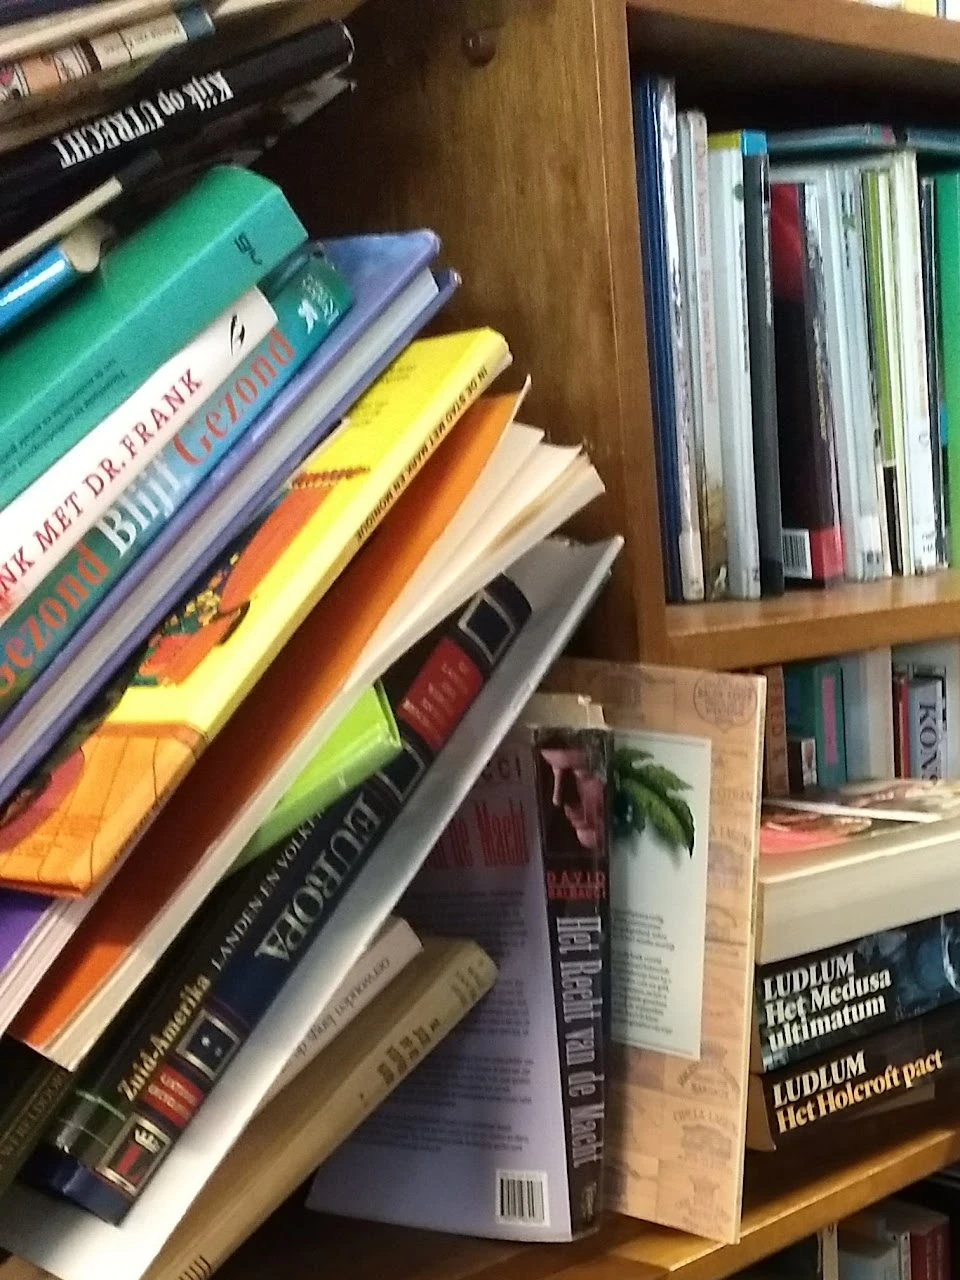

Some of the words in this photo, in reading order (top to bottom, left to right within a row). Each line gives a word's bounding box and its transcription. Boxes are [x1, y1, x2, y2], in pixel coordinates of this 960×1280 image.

[158, 90, 185, 116] op
[182, 70, 234, 111] Kijk
[52, 100, 164, 169] UTRECHT
[464, 378, 479, 394] DE
[474, 365, 490, 382] IN
[425, 421, 448, 446] MET
[441, 393, 469, 423] STAD
[96, 448, 184, 558] Blijf
[174, 327, 295, 466] Gezond
[402, 443, 432, 476] MARK
[390, 473, 408, 492] EN
[32, 491, 83, 548] MET
[352, 490, 397, 541] MONIQUE
[254, 791, 381, 962] EUROPA
[211, 896, 262, 971] LANDEN
[260, 871, 280, 897] EN
[557, 915, 602, 954] Het
[559, 959, 604, 1024] Recht
[763, 952, 856, 1001] LUDLUM
[765, 996, 807, 1029] Het
[811, 969, 892, 1013] Medusa
[116, 972, 213, 1102] Zuid-Amerika
[565, 1027, 596, 1066] van
[768, 994, 887, 1051] ultimatum
[567, 1070, 605, 1098] de
[773, 1051, 867, 1109] LUDLUM
[776, 1101, 816, 1134] Het
[817, 1065, 901, 1117] Holcroft
[902, 1049, 944, 1089] pact
[570, 1101, 605, 1169] Macht
